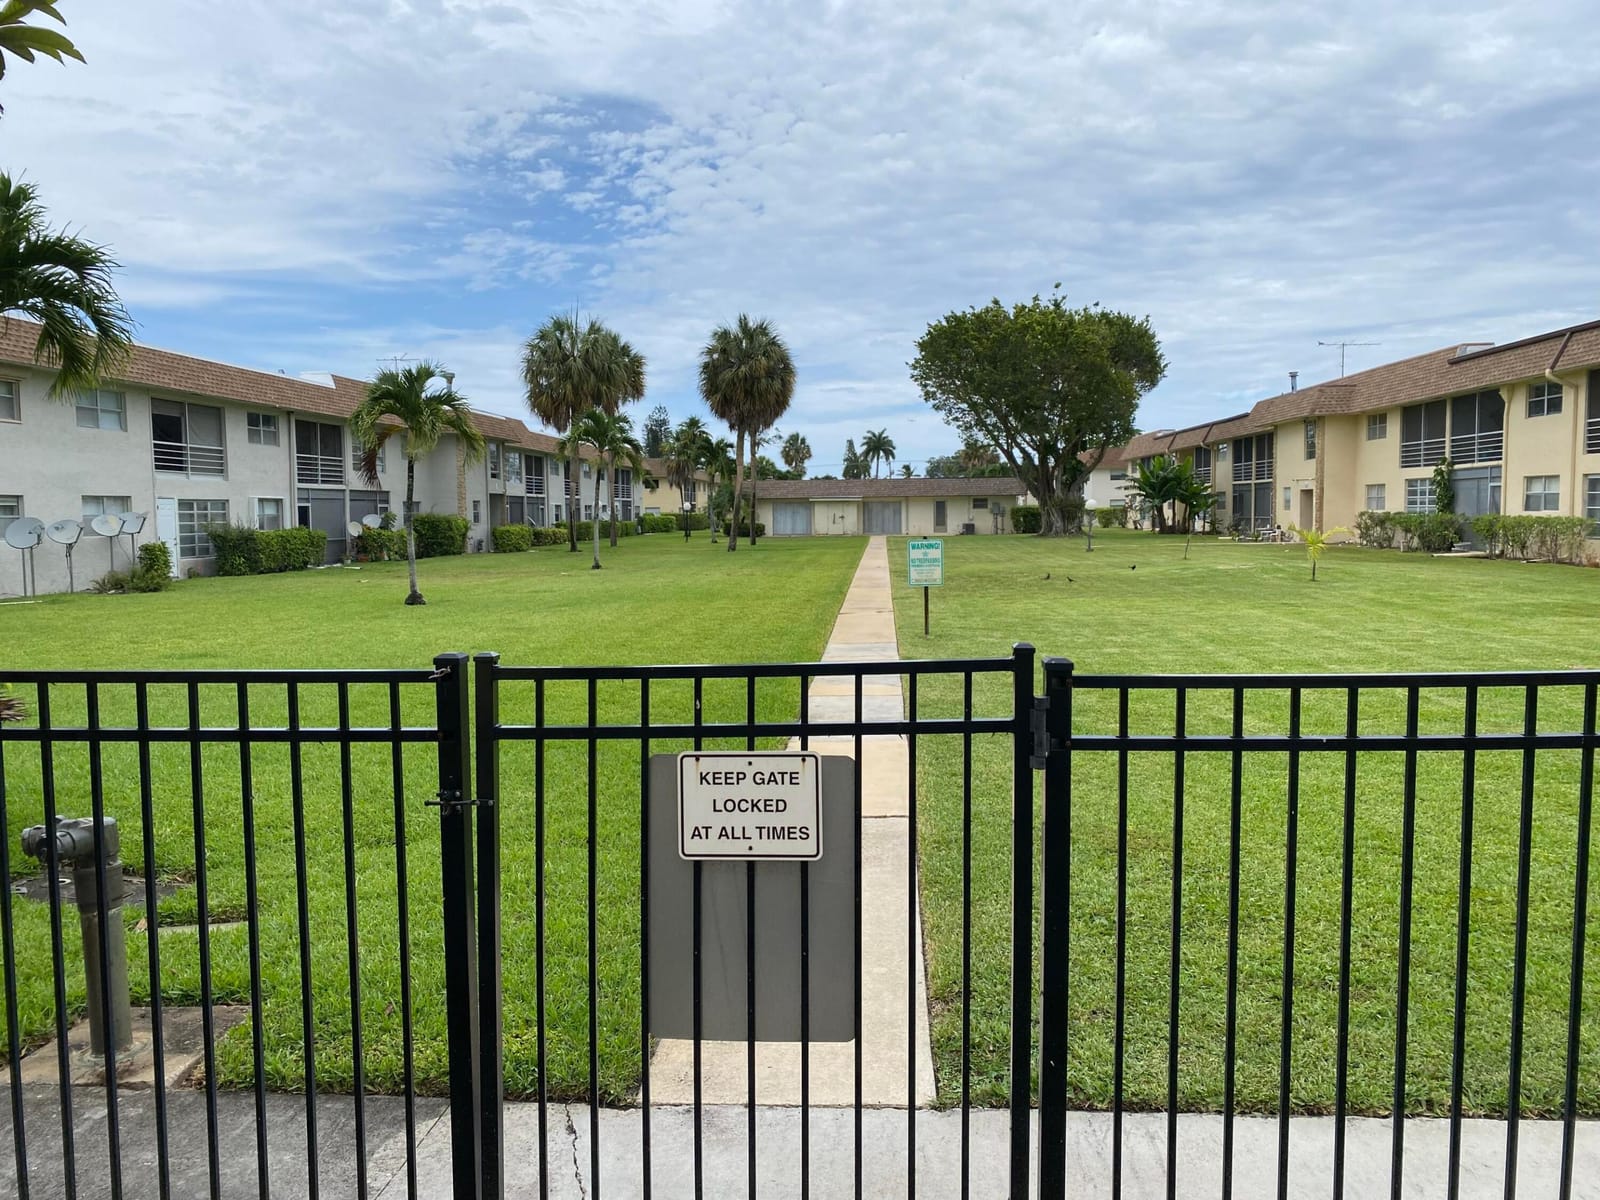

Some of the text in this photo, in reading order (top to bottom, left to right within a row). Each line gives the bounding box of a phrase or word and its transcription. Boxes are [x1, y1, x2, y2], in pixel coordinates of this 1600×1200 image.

[699, 771, 800, 786] KEEP GATE
[712, 798, 788, 813] LOCKED
[690, 826, 810, 840] AT ALL TIMES
